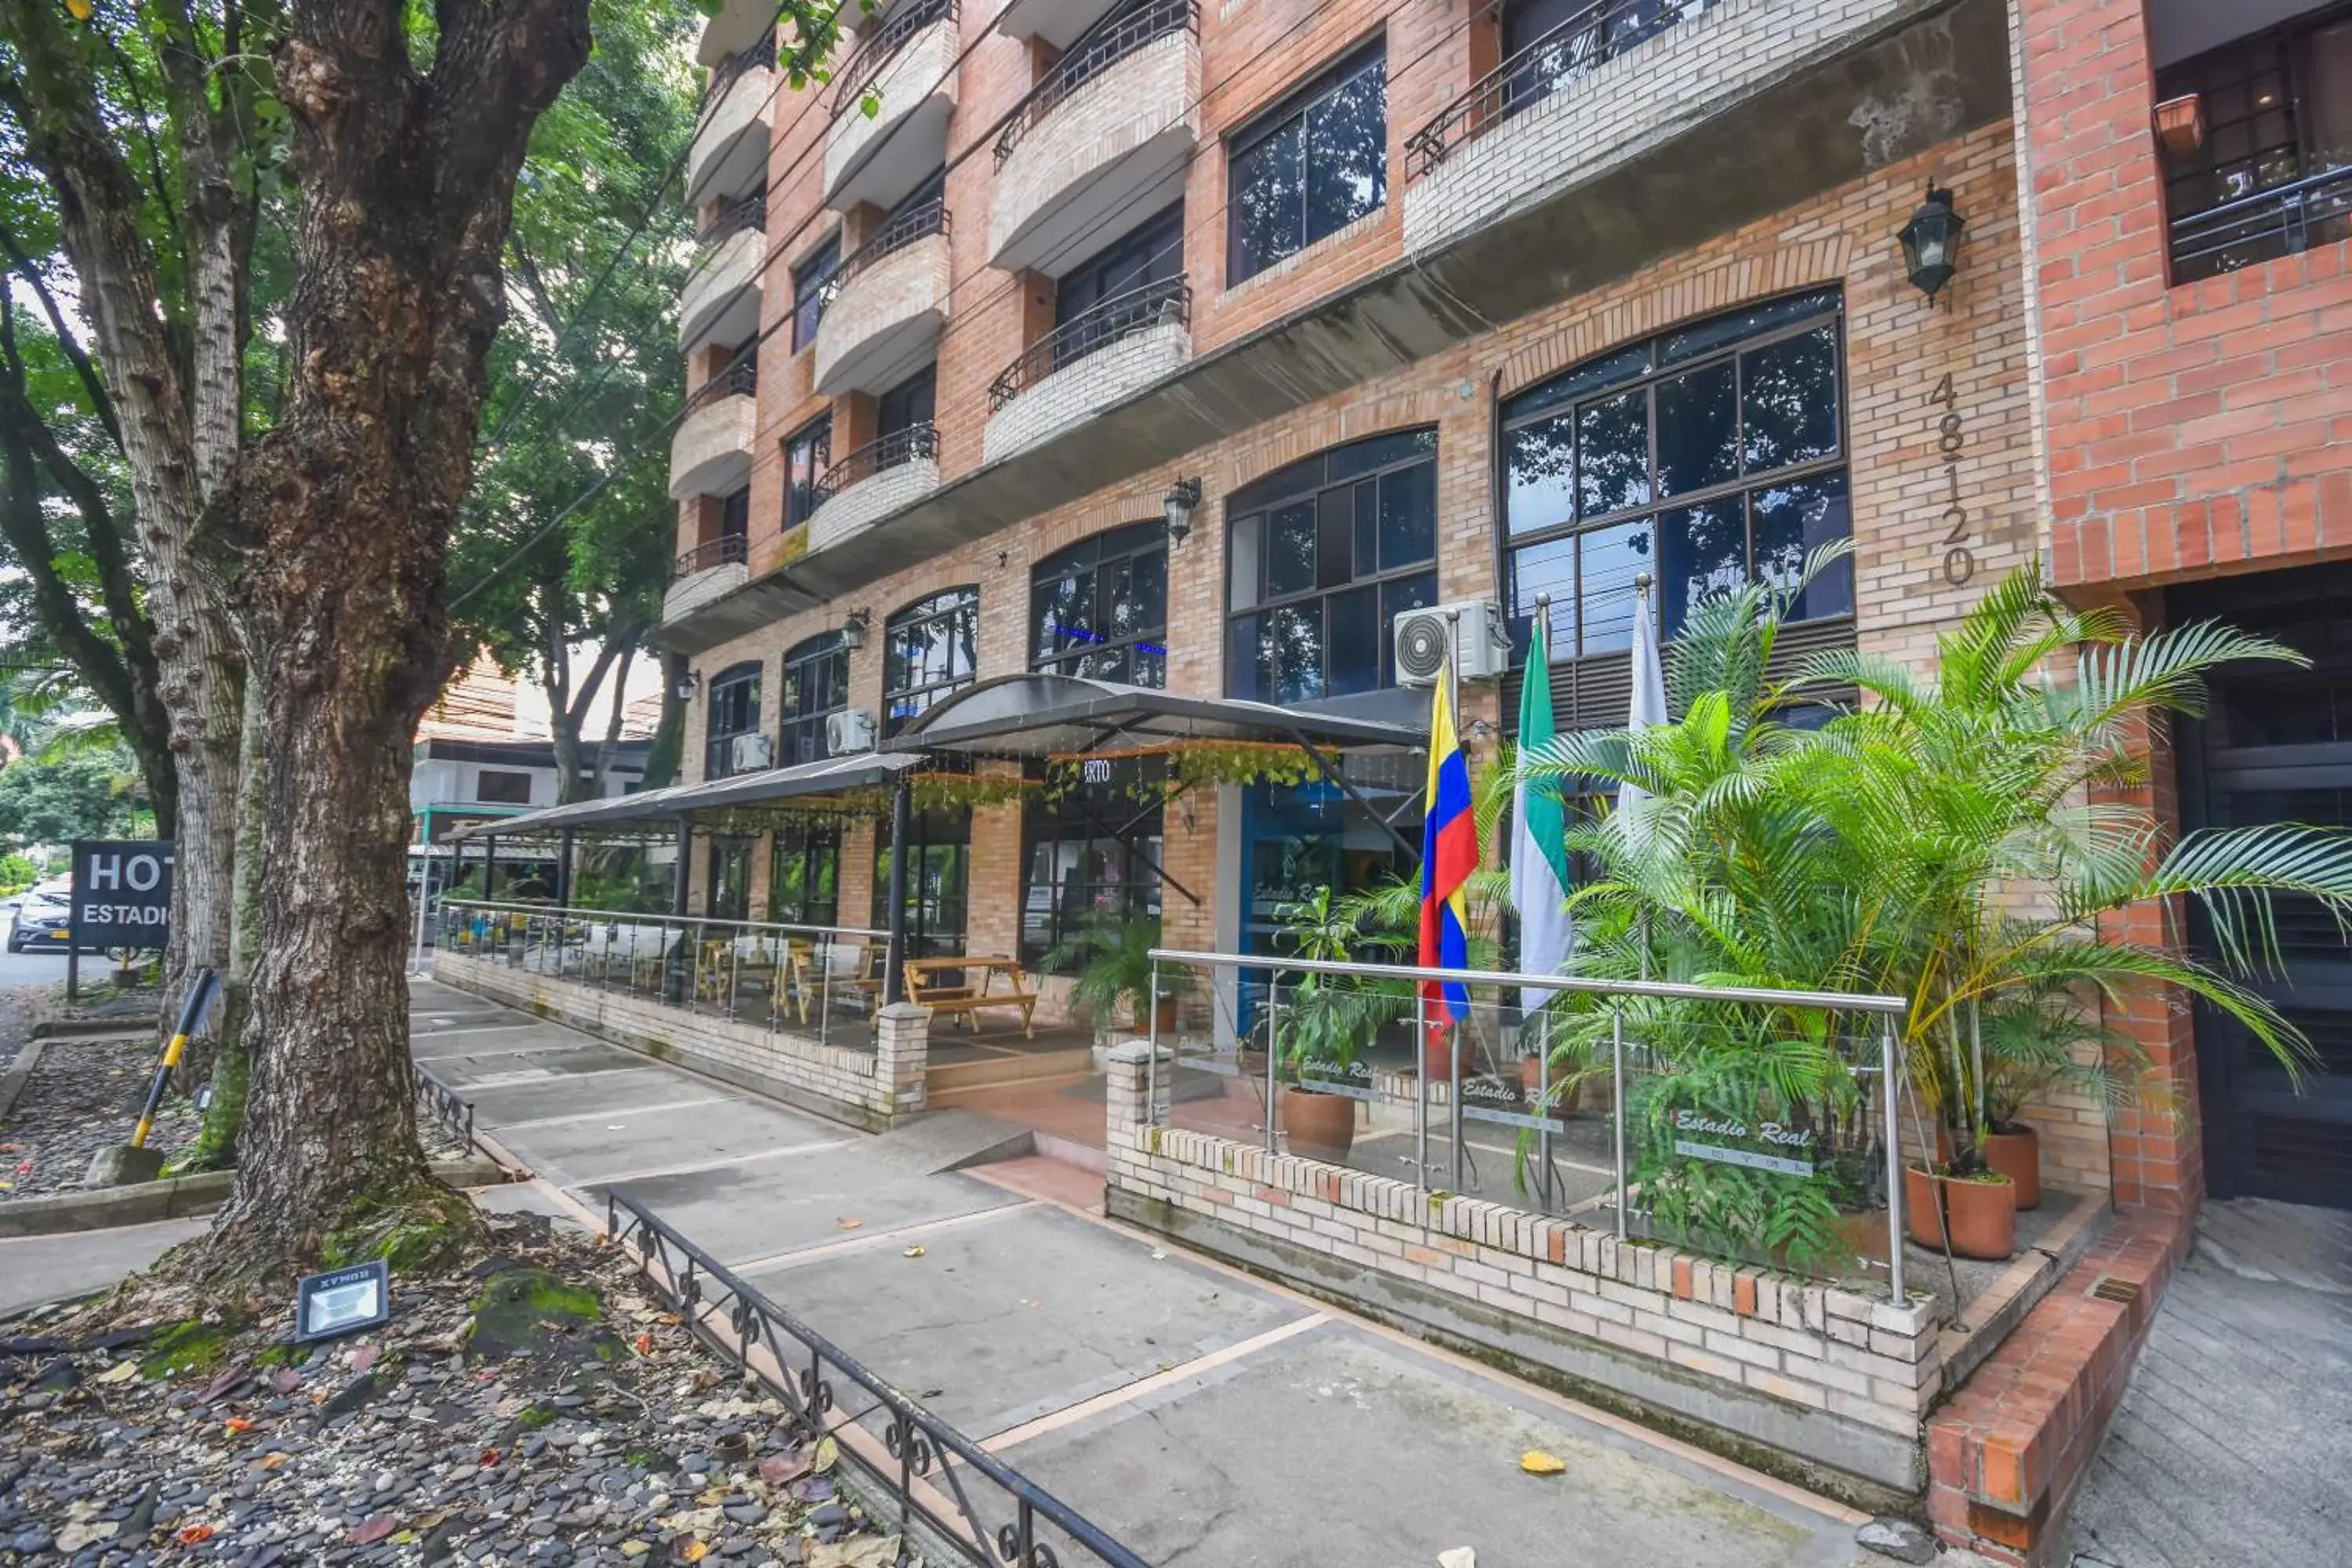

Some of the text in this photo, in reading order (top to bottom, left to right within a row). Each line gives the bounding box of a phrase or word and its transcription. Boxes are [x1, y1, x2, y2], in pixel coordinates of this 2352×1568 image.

[1929, 371, 1975, 586] 48-120
[82, 903, 172, 925] ESTADI
[1461, 1079, 1515, 1101] Estadio
[1676, 1109, 1810, 1147] Estadio Real
